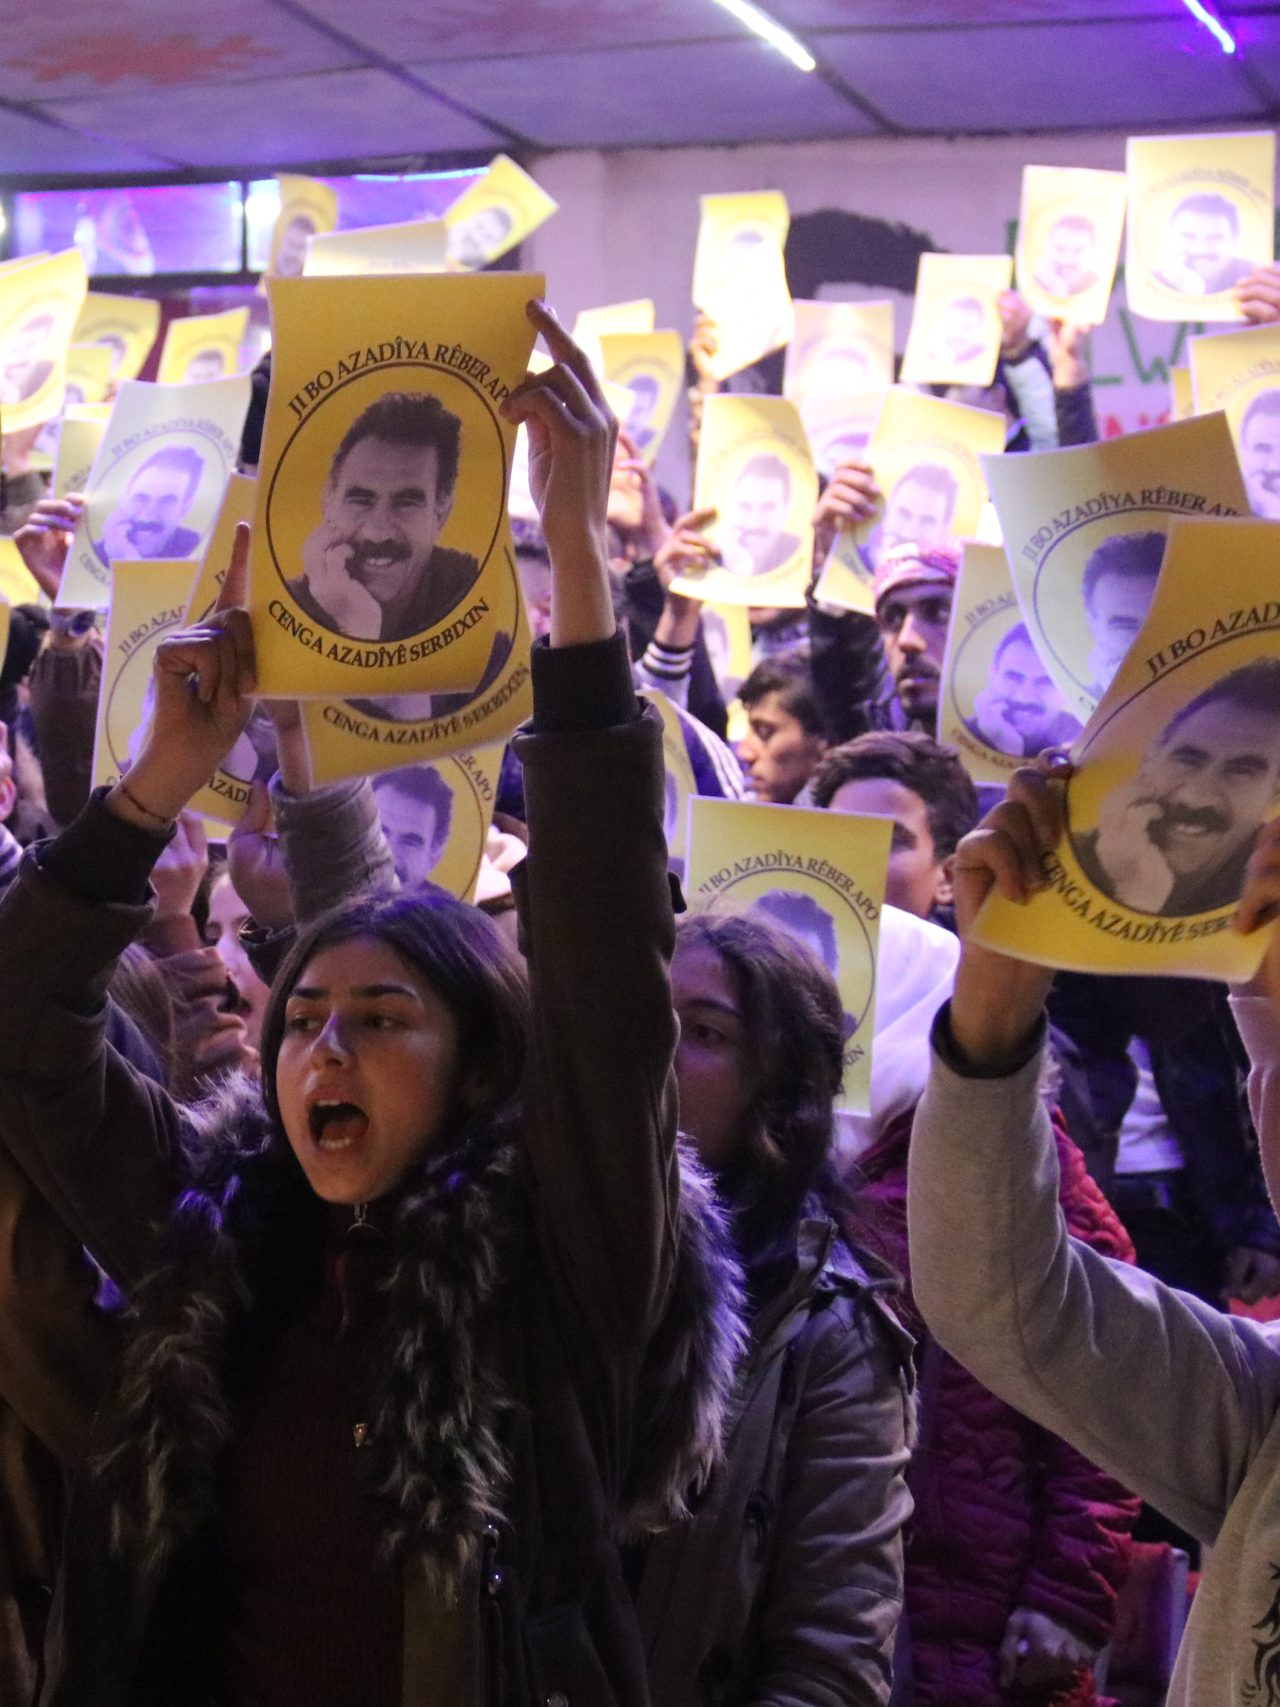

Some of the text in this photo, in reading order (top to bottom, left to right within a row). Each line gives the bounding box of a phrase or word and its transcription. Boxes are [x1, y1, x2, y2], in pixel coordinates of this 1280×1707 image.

[288, 335, 510, 421] JI BO AZADÎYA RÊBER AP
[1052, 490, 1137, 533] AZADÎYA
[1140, 485, 1207, 511] RÊBER
[1021, 542, 1040, 566] JI
[1029, 526, 1054, 550] BO
[128, 623, 150, 642] BO
[268, 597, 491, 669] CENGA AZADÎYÊ SERBIXIN
[1145, 602, 1280, 679] JI BO AZAD
[322, 661, 531, 745] CENGA AZADÎYÊ SERBIXIN
[471, 769, 493, 801] APO
[709, 868, 732, 890] BO
[733, 849, 804, 877] AZADÎYA
[806, 857, 855, 893] RÊBER
[852, 888, 879, 921] APO
[1089, 909, 1187, 944] AZADÎYÊ
